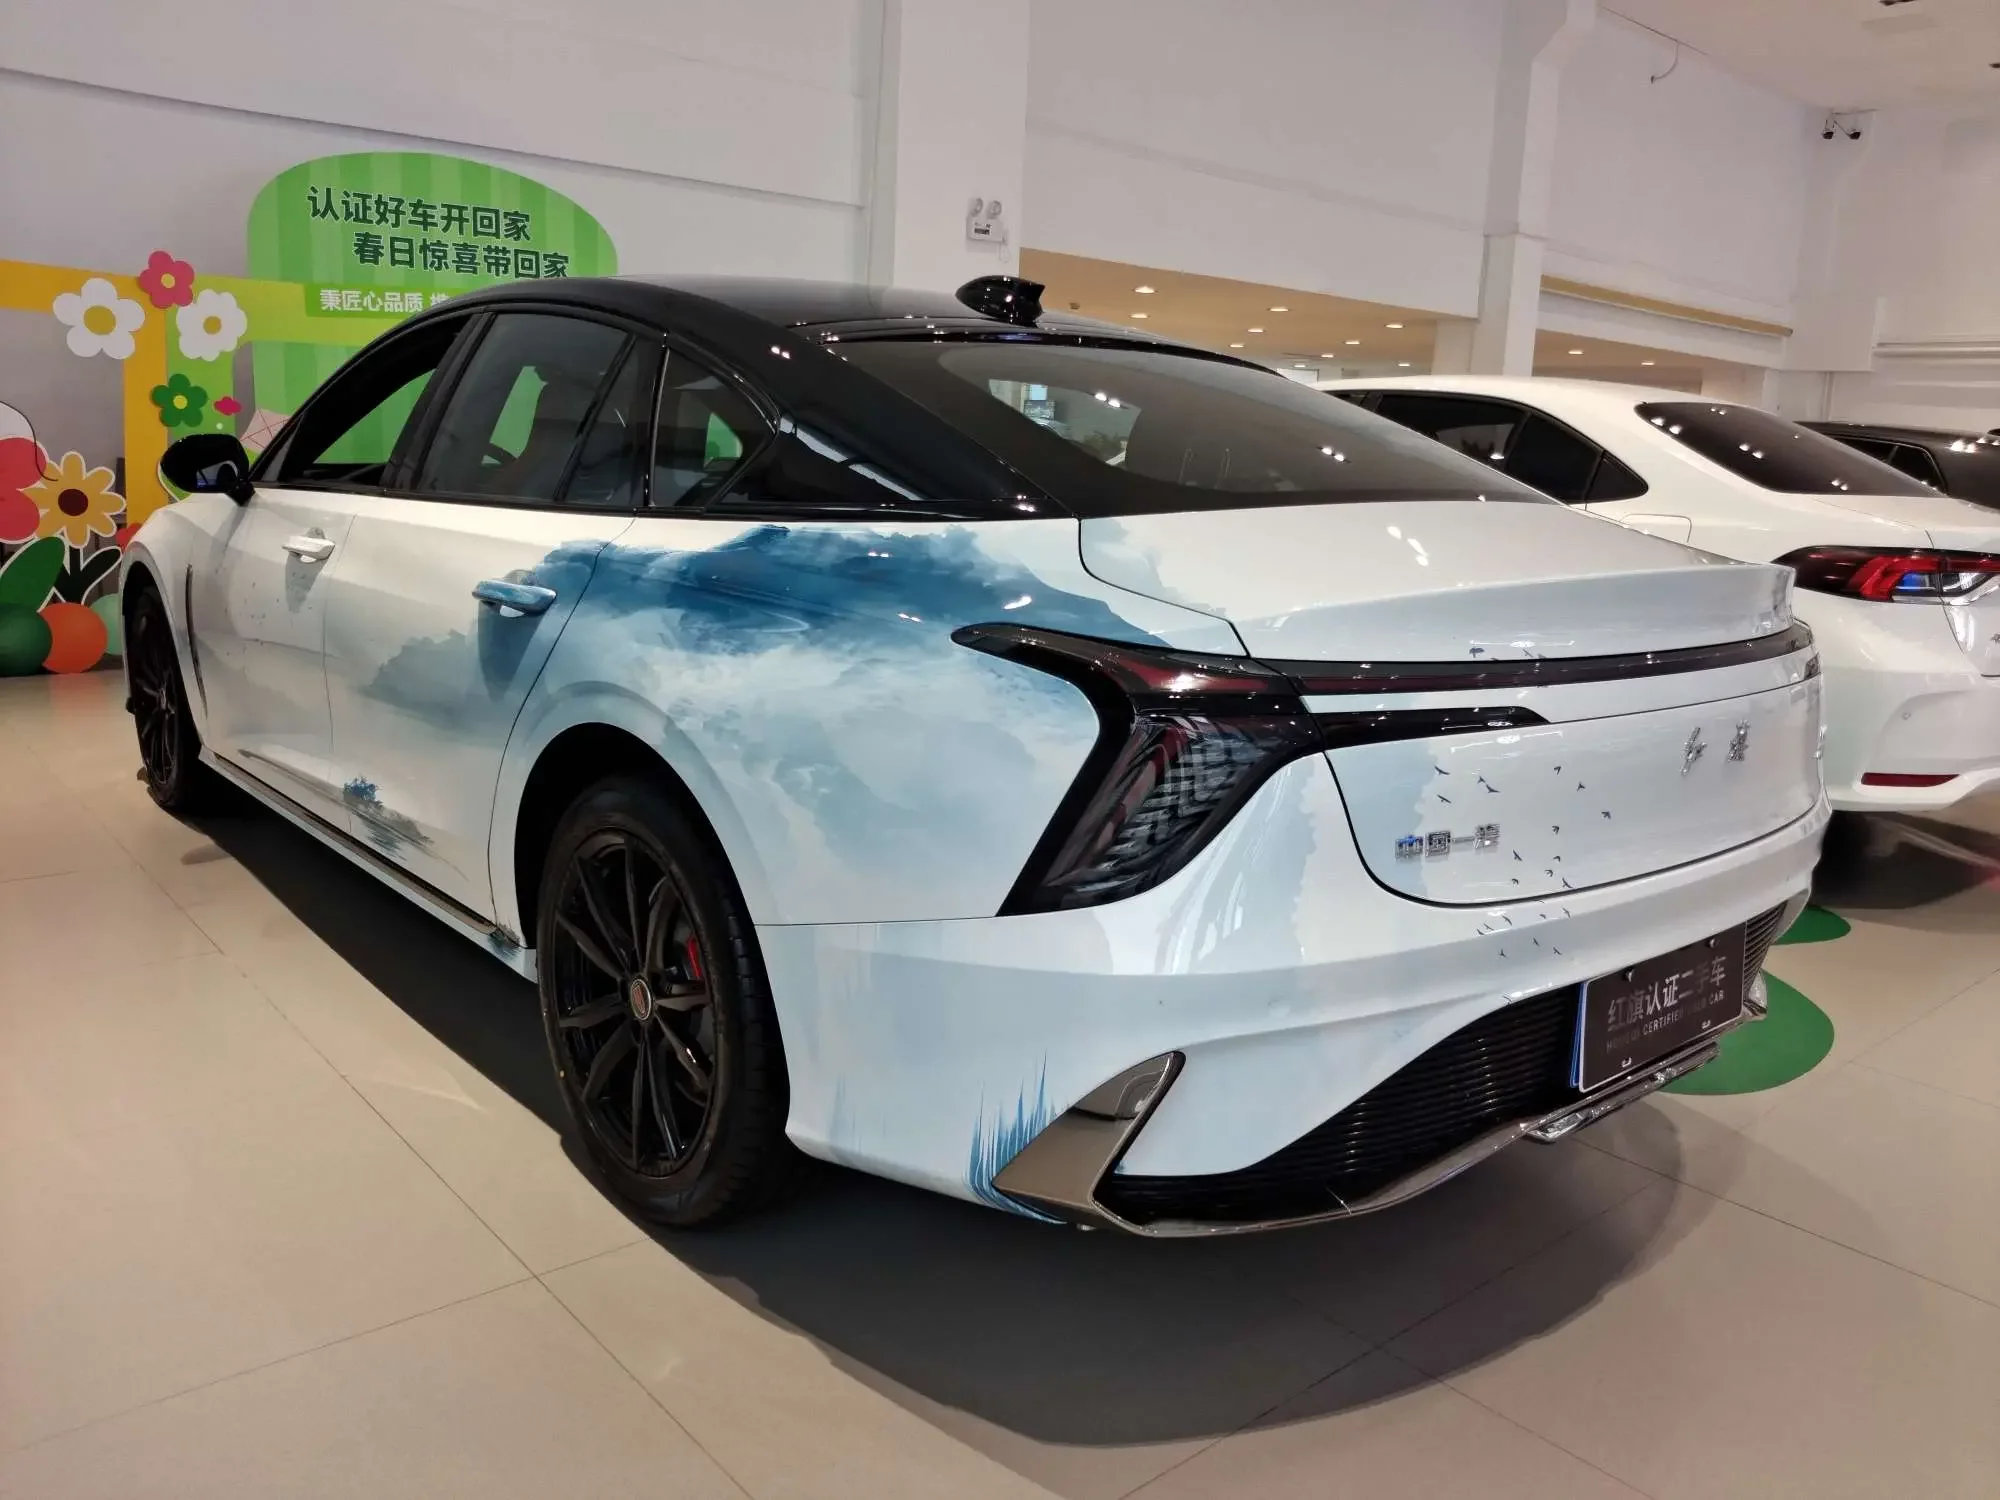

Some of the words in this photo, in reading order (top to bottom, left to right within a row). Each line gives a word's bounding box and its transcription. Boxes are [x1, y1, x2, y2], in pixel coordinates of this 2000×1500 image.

[306, 185, 531, 242] 认证好车开回家
[353, 231, 569, 279] 春日惊喜带回家
[319, 288, 424, 312] 秉匠心品质
